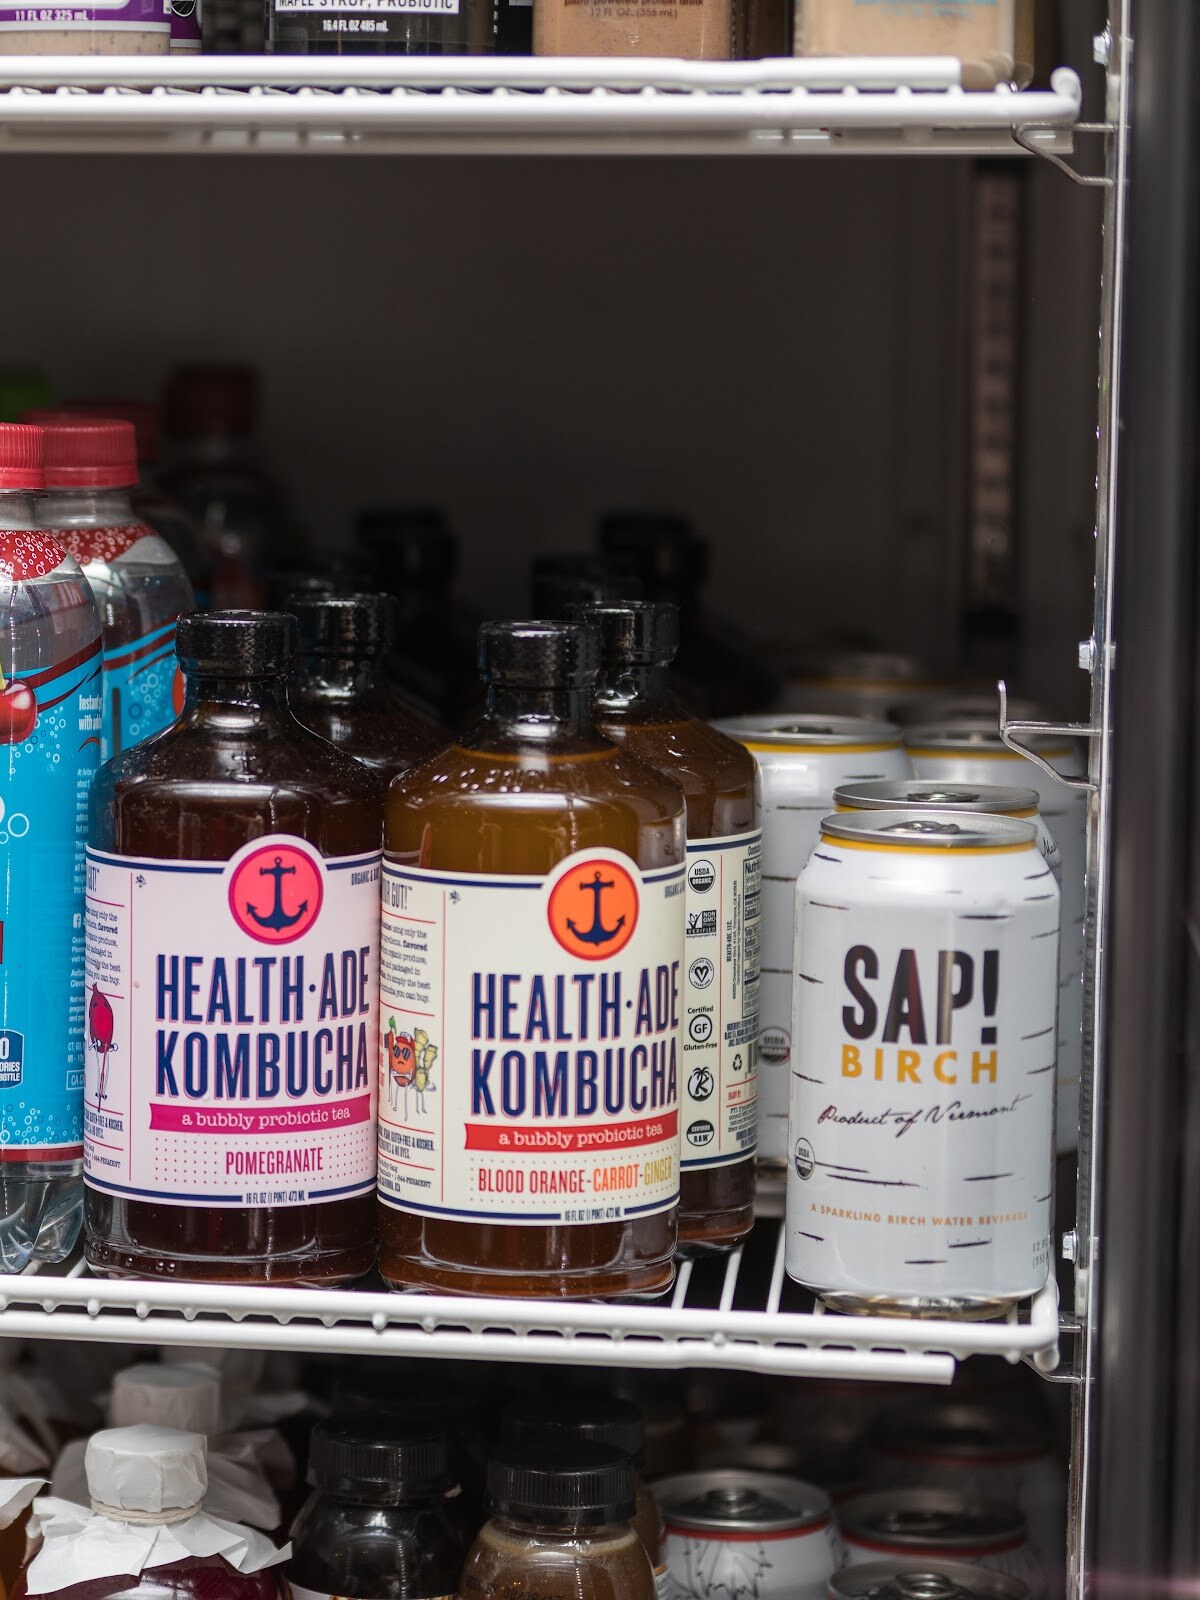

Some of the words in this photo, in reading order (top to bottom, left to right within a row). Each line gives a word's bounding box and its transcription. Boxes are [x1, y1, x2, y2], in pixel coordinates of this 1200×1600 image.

[694, 867, 710, 876] USDA
[686, 927, 716, 935] VERIFIED
[402, 939, 428, 953] flavored
[841, 943, 1001, 1046] SAP!
[687, 1005, 714, 1015] Certified
[694, 1023, 708, 1034] GF
[683, 1042, 718, 1052] Gluten-Free
[155, 1021, 370, 1100] KOMBUCHA
[840, 1043, 999, 1085] BIRCH
[471, 1037, 678, 1120] KOMBUCHA
[181, 1115, 193, 1127] a
[196, 1112, 255, 1130] bubbly
[258, 1109, 329, 1130] probiotic
[331, 1107, 351, 1120] tea
[817, 1104, 894, 1126] Product
[894, 1108, 923, 1139] of
[924, 1093, 1033, 1123] Vermont
[498, 1134, 511, 1146] a
[514, 1130, 573, 1150] bubbly
[576, 1126, 644, 1149] probiotic
[645, 1123, 664, 1137] tea
[693, 1133, 709, 1143] RAW
[225, 1146, 324, 1175] POMEGRANATE
[478, 1168, 525, 1194] BLOOD
[819, 1204, 882, 1224] SPARKLING
[887, 1215, 926, 1226] BIRCH
[931, 1215, 974, 1227] WATER
[977, 1210, 1029, 1226] BEVERAGE
